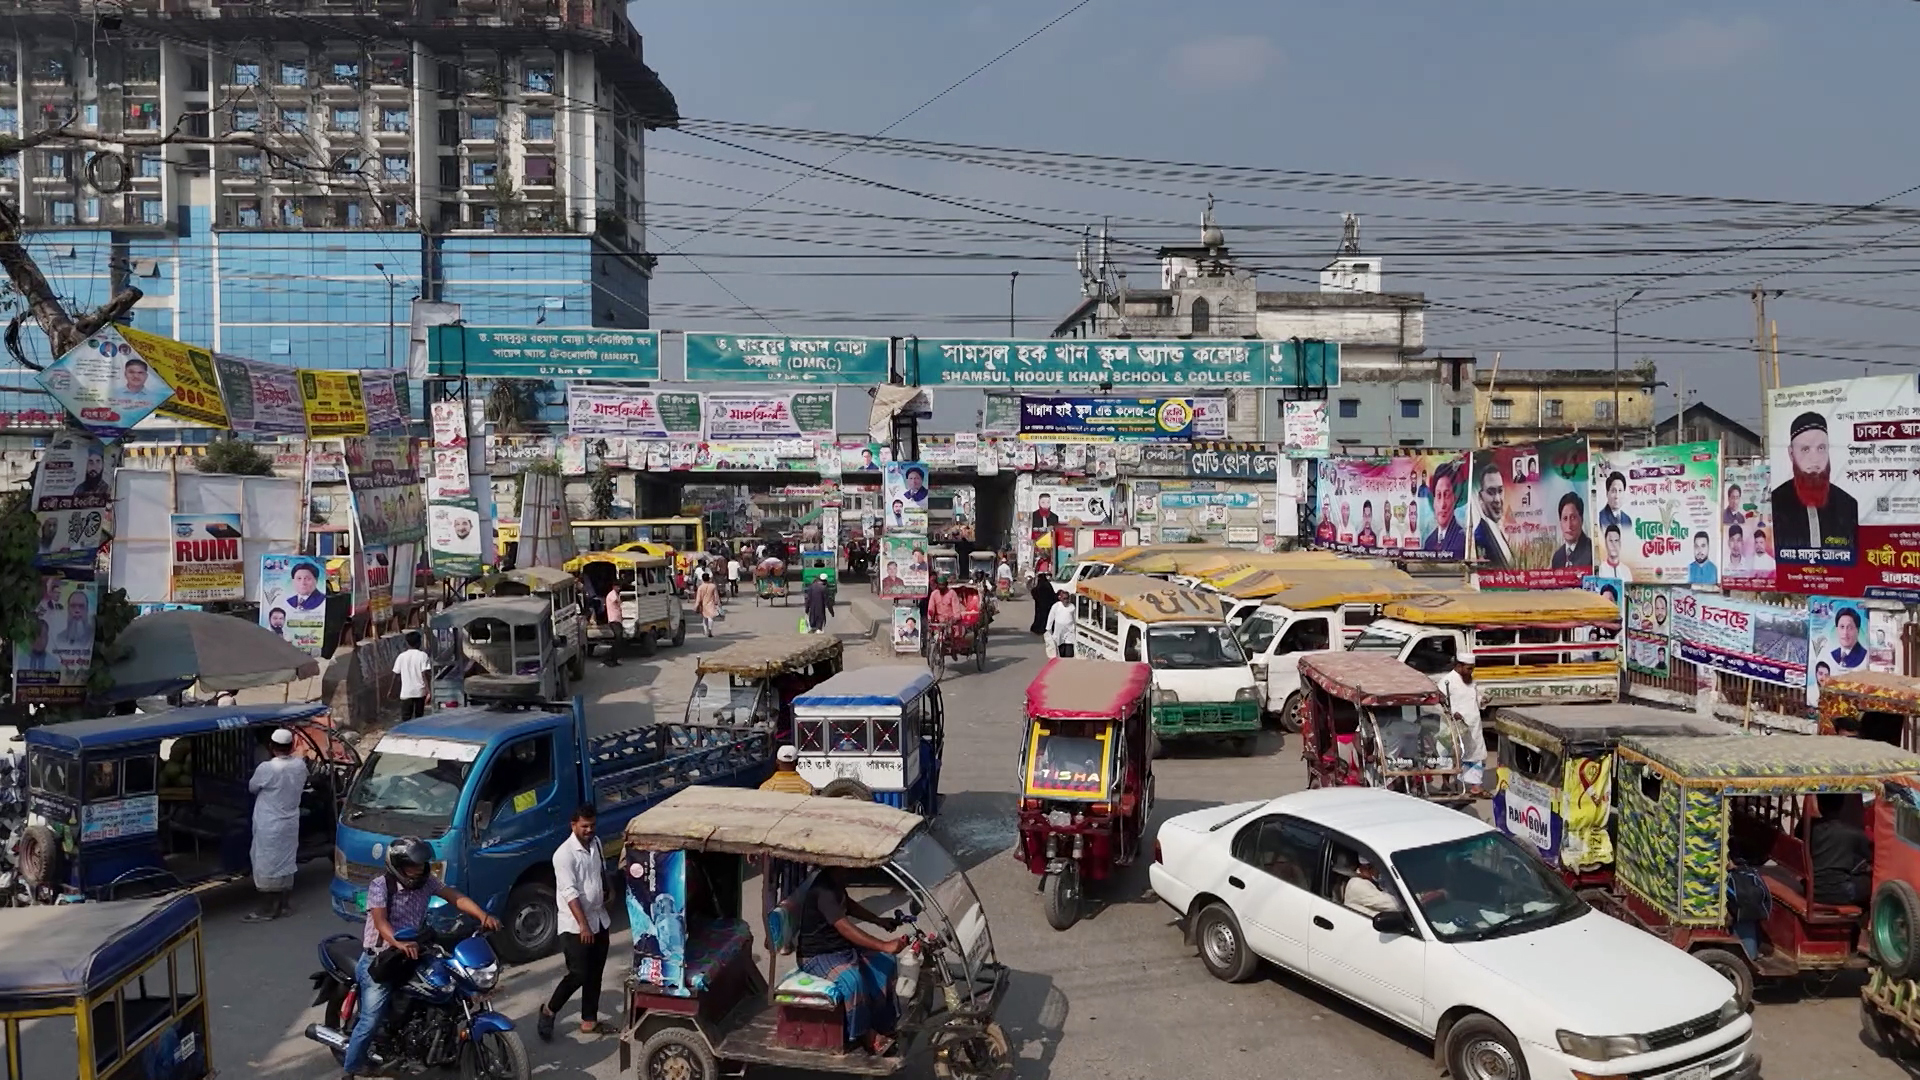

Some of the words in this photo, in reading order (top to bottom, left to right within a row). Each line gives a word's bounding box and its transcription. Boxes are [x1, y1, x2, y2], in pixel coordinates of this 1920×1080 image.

[530, 334, 559, 345] রহমান
[789, 338, 829, 354] রহমান
[834, 340, 868, 356] মোল্লা
[787, 356, 842, 372] (DMRC)
[940, 343, 1010, 371] সামসুল
[1015, 344, 1049, 366] হক
[1054, 343, 1090, 365] খান
[1094, 344, 1132, 371] স্কুল
[1191, 346, 1251, 366] কলেজ
[941, 371, 1011, 383] SHAMSUL
[1014, 371, 1065, 382] HOQUE
[1068, 371, 1109, 382] KHAN
[1112, 370, 1169, 382] SCHOOL
[1173, 371, 1184, 382] &
[1187, 369, 1251, 383] COLLEGE
[1025, 403, 1054, 418] মান্নান
[1054, 402, 1073, 418] হাই
[1074, 404, 1093, 419] স্কুল
[1856, 423, 1897, 439] ঢাকা-৫
[1900, 422, 1920, 436] আস
[1846, 469, 1875, 483] সংসদ
[1878, 468, 1909, 482] সদস্য
[1635, 516, 1664, 540] ধানের
[1669, 519, 1690, 540] শীষে
[176, 538, 239, 562] RUIM
[1642, 536, 1665, 558] ভোট
[1865, 543, 1897, 568] হাজী
[1797, 549, 1821, 564] মাসুদ
[1821, 548, 1851, 562] আলম
[368, 567, 389, 588] RUIM
[1673, 594, 1698, 619] ভর্তি
[1701, 604, 1751, 632] চলছে
[1484, 685, 1545, 698] আল্লাহর
[1548, 685, 1573, 696] দান
[815, 758, 832, 770] ভাই
[1041, 768, 1101, 783] TISHA
[1508, 805, 1549, 838] RAINBOW
